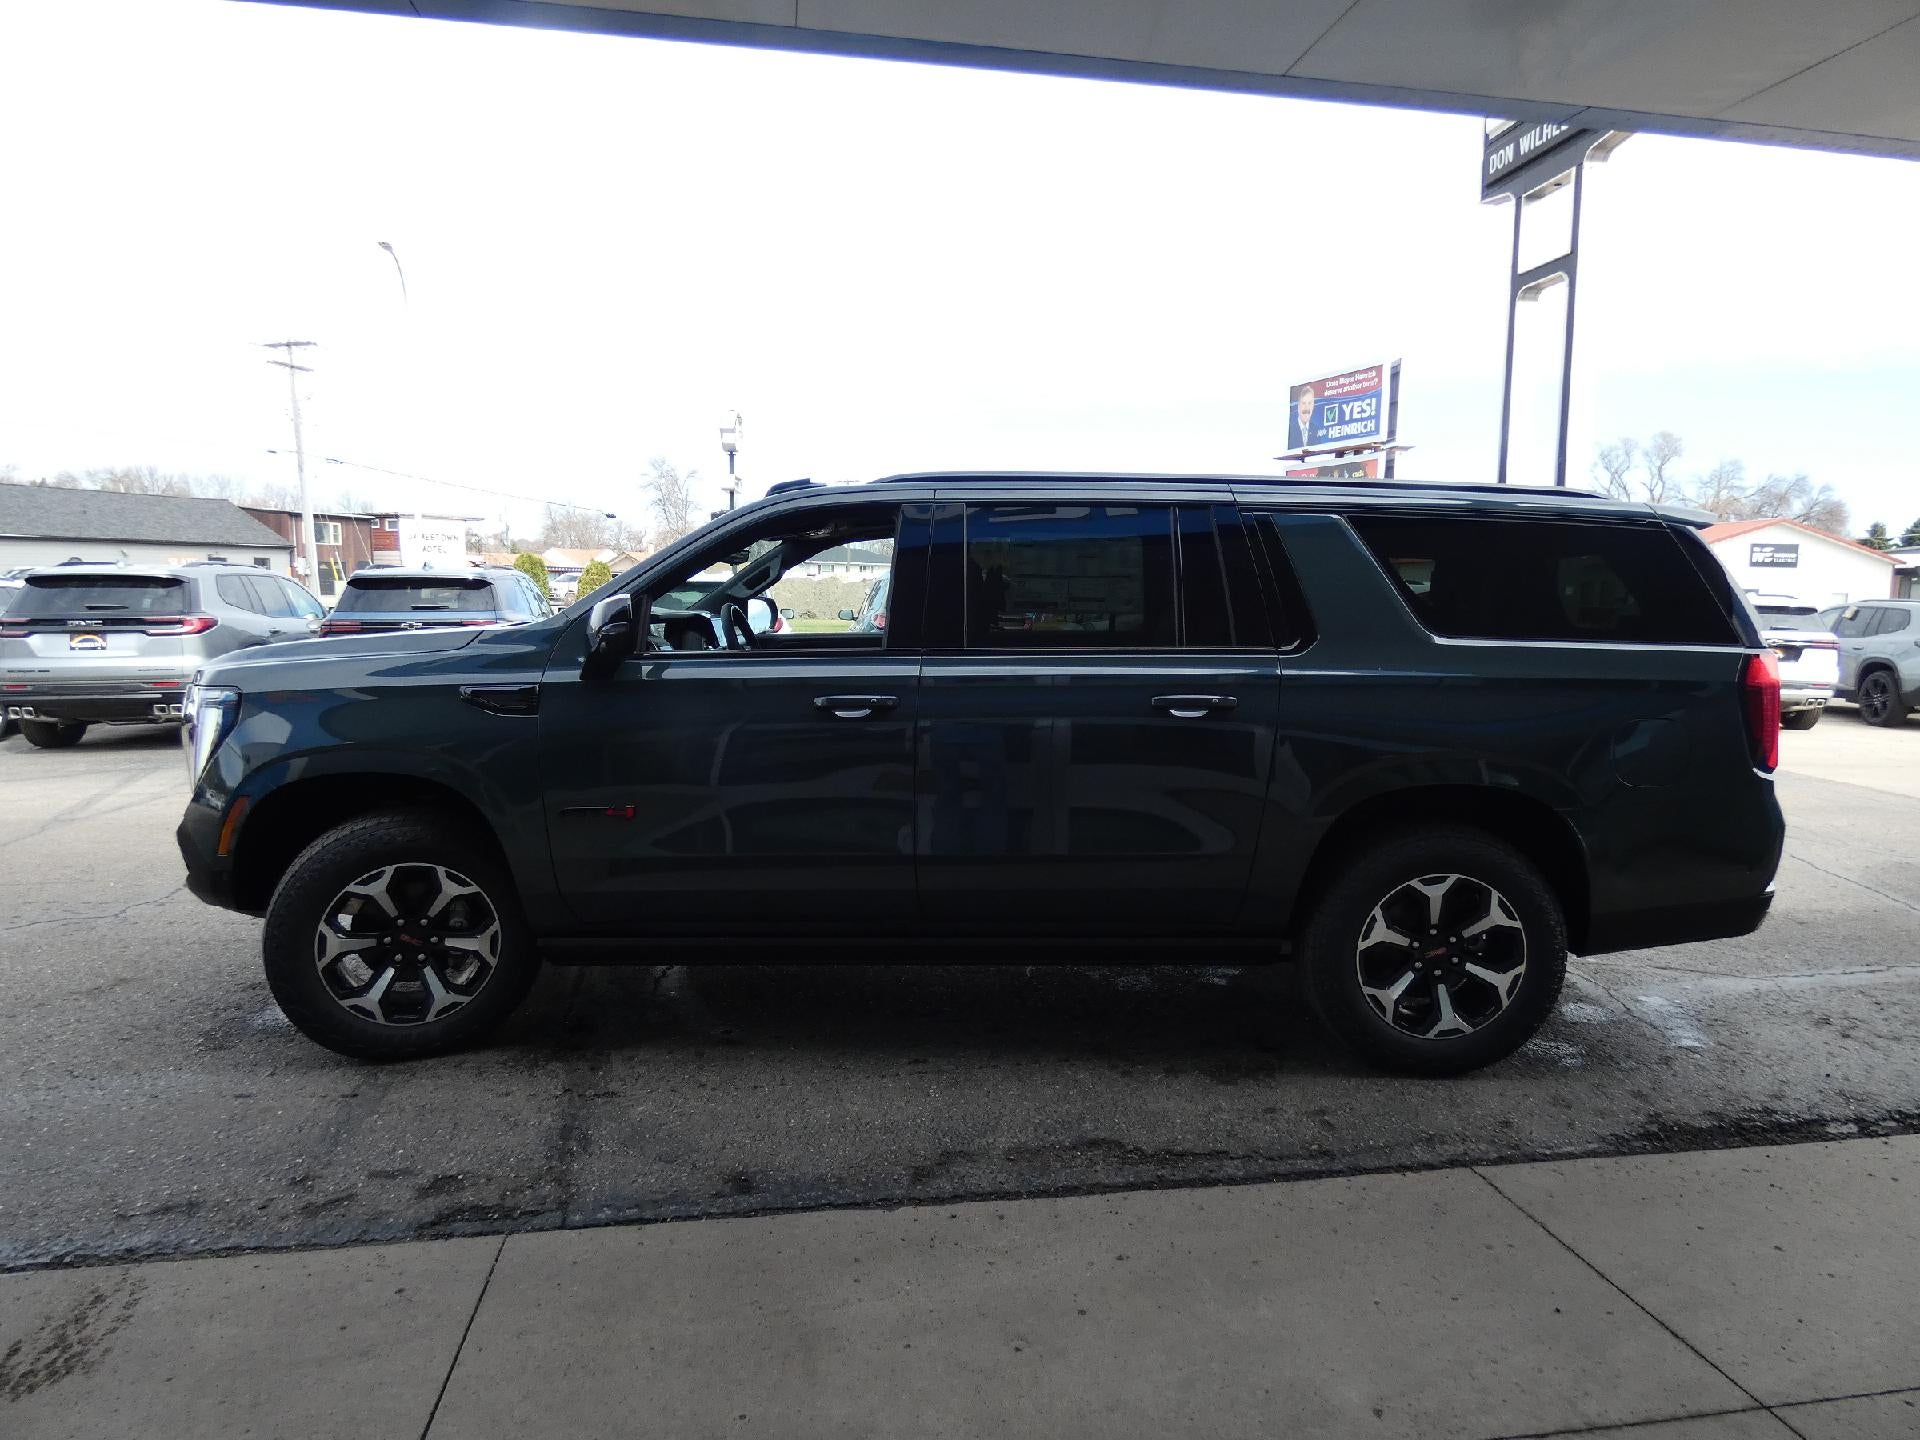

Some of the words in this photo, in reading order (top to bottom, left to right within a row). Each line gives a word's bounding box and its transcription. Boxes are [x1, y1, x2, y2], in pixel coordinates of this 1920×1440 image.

[1489, 143, 1514, 174] DON
[1341, 398, 1377, 420] YES!
[1328, 419, 1375, 438] HEINRICH
